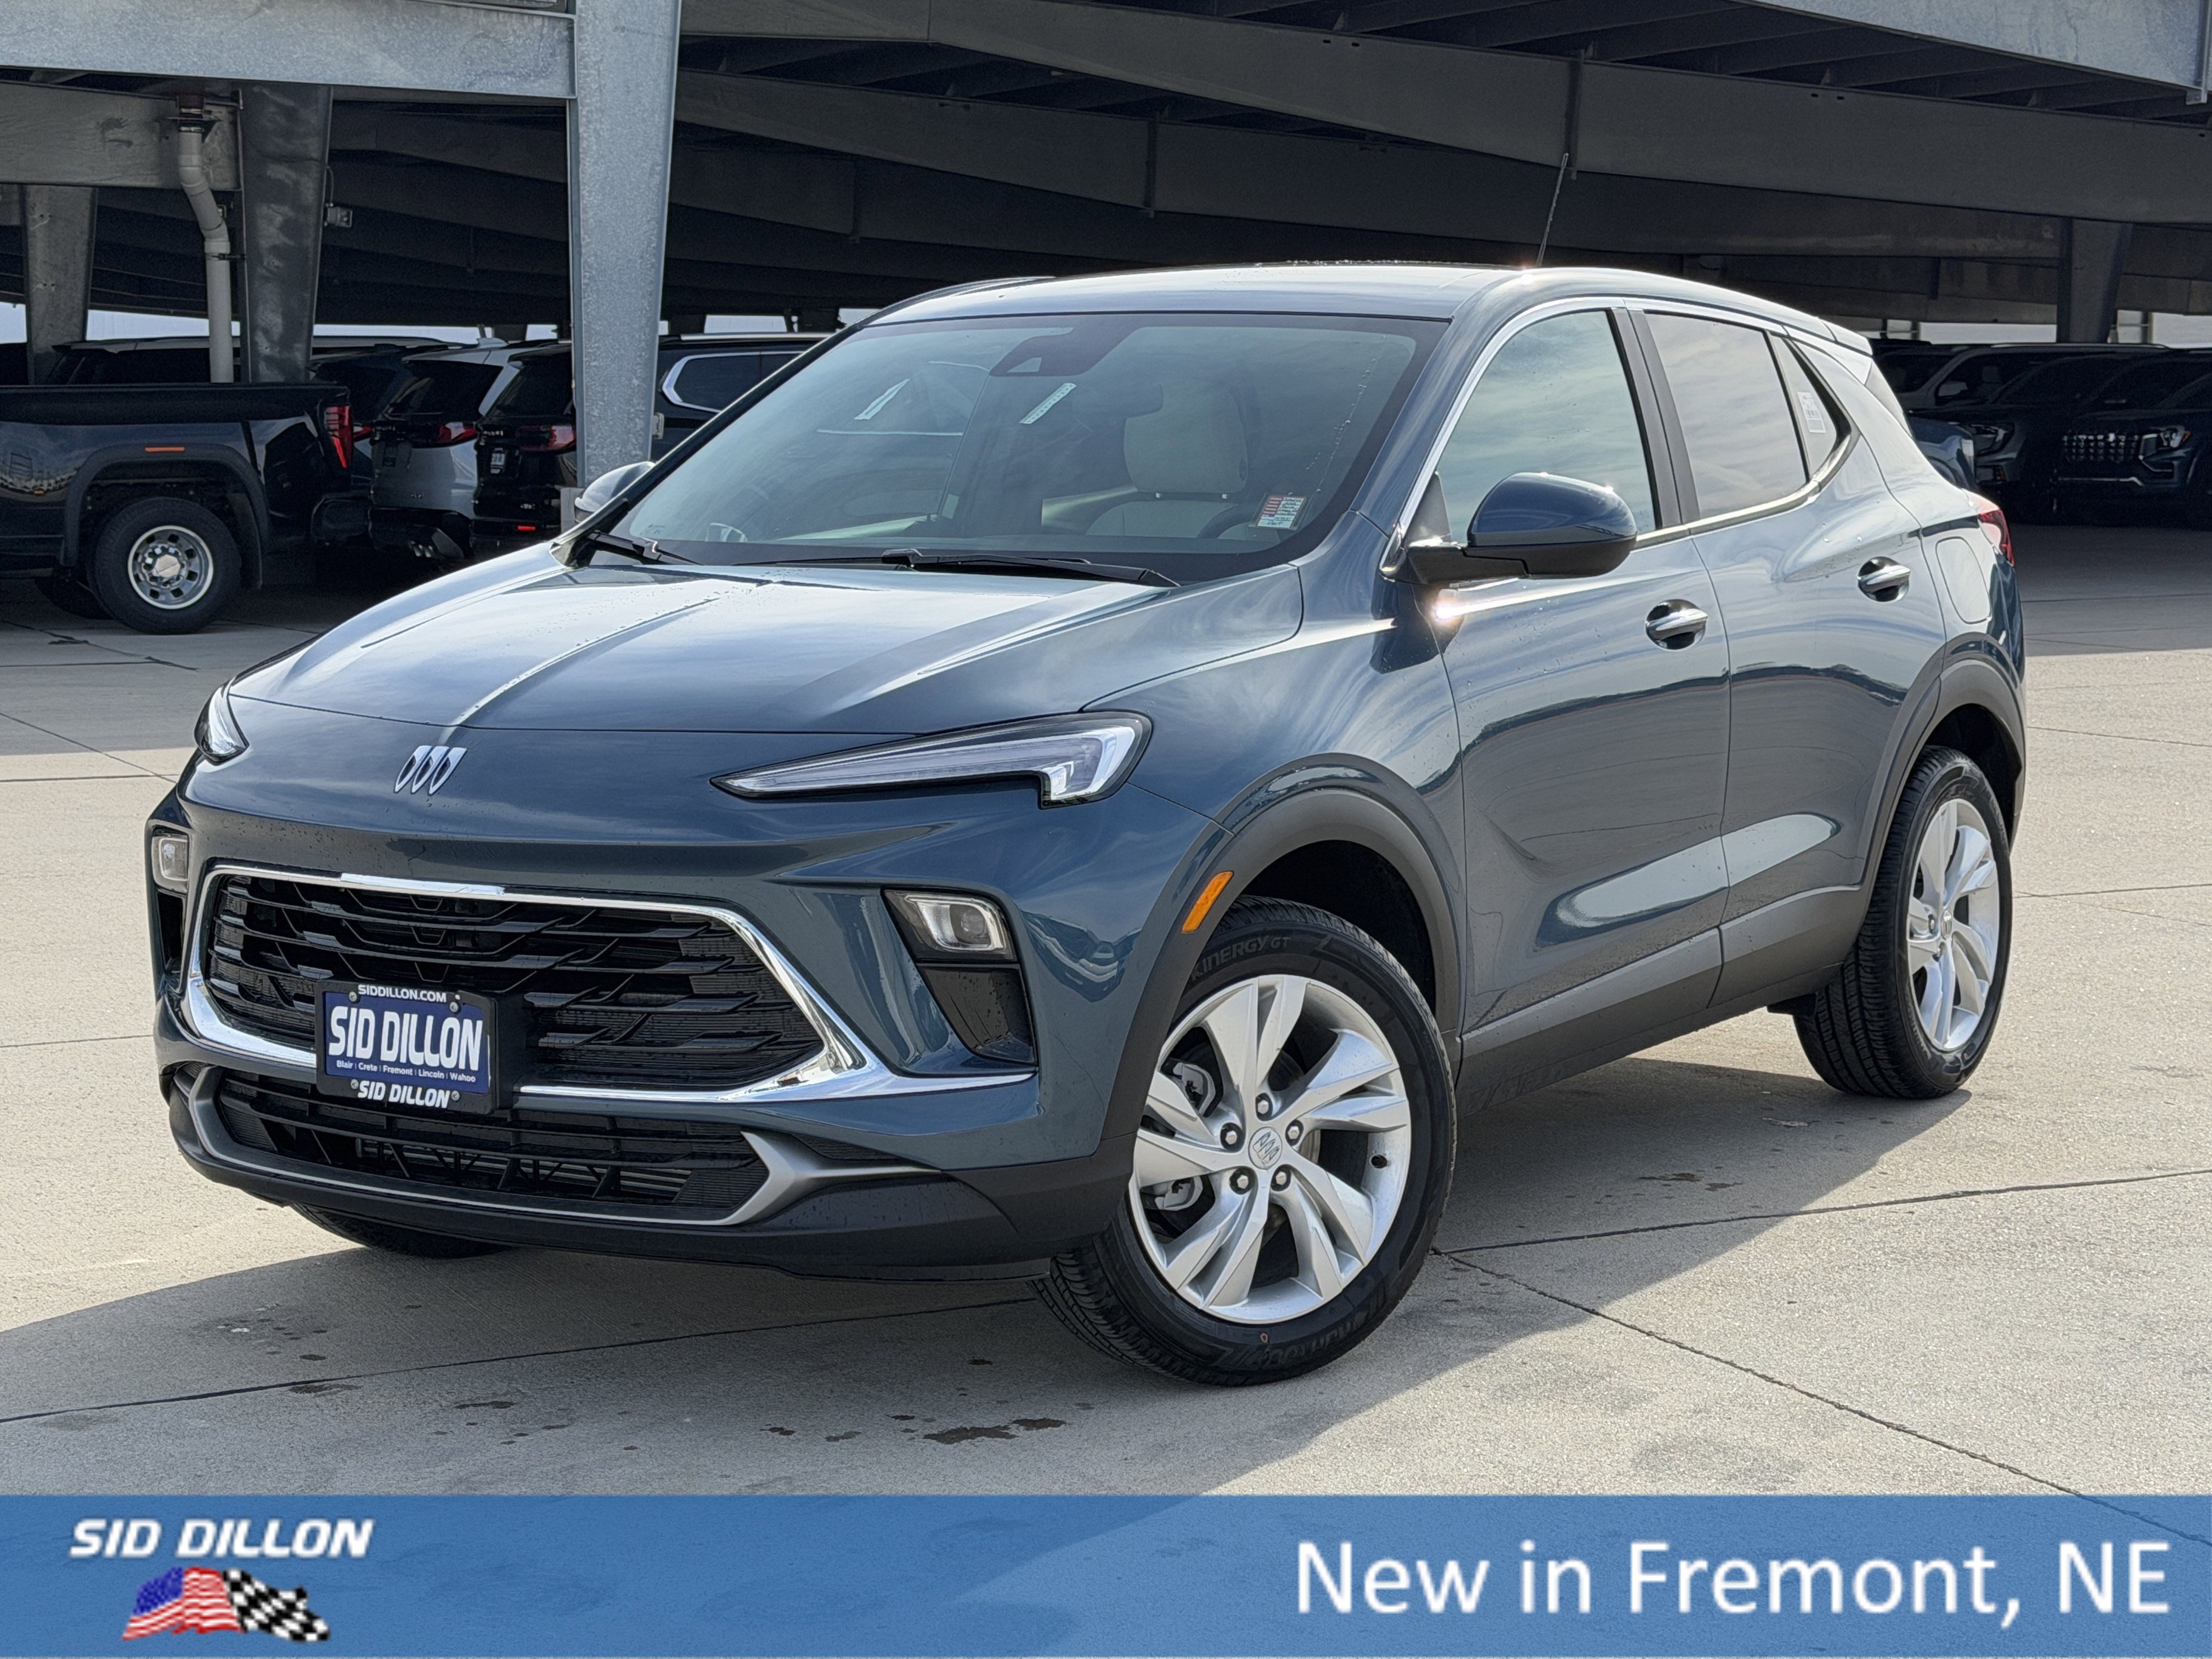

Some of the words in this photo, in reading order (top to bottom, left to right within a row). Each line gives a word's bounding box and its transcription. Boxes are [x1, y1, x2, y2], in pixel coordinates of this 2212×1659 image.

[1270, 936, 1292, 949] GT
[358, 984, 447, 1003] SIDDILLON.COM
[329, 1006, 375, 1059] SID
[380, 1011, 483, 1071] DILLON
[336, 1060, 353, 1069] Blair
[358, 1062, 377, 1072] Crete
[418, 1069, 444, 1079] Lincoln
[450, 1072, 476, 1082] Wahoo
[358, 1080, 386, 1101] SID
[388, 1084, 450, 1109] DILLON
